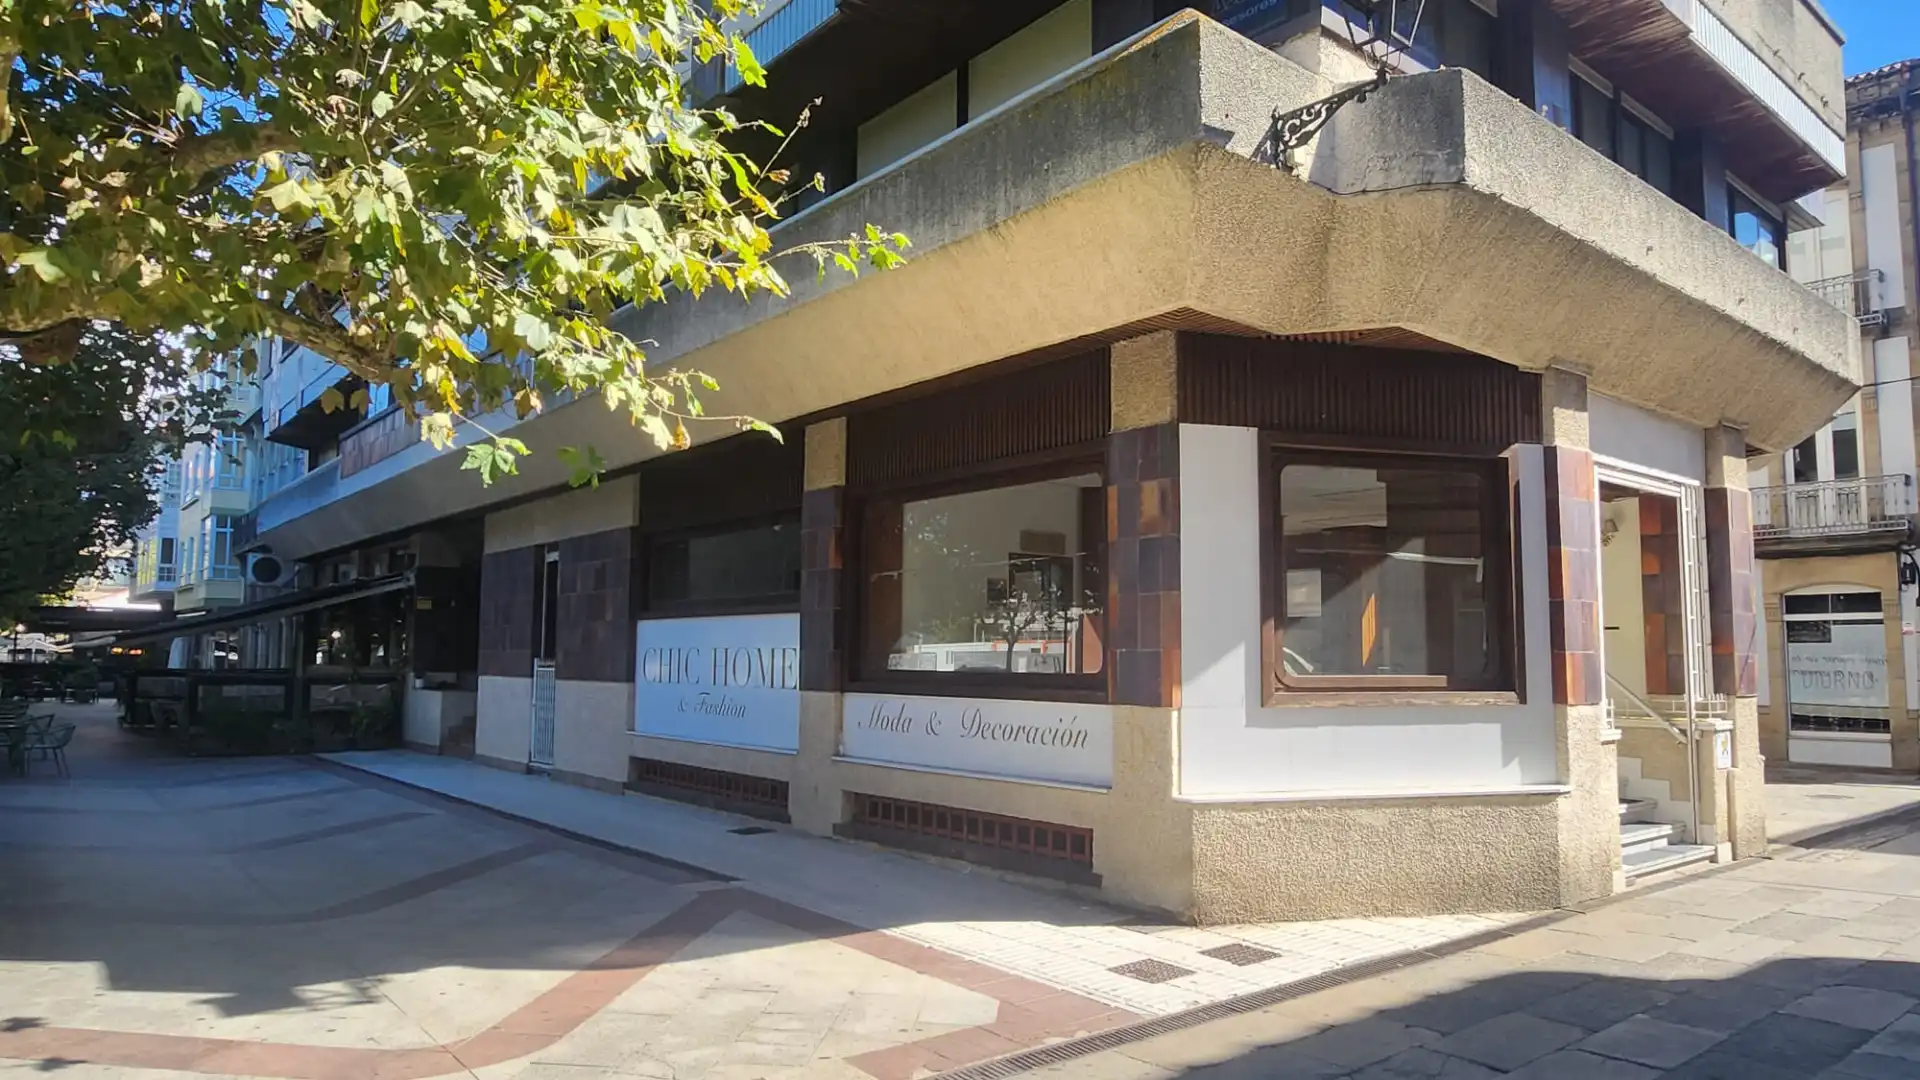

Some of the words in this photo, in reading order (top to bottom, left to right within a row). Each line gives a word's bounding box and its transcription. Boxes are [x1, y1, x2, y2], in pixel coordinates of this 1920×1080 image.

[642, 646, 701, 685] CHIC
[711, 646, 798, 690] HOME
[676, 696, 689, 714] &
[693, 691, 747, 721] Fashion
[857, 700, 913, 734] Moda
[925, 710, 942, 737] &
[959, 706, 1090, 751] Decoración
